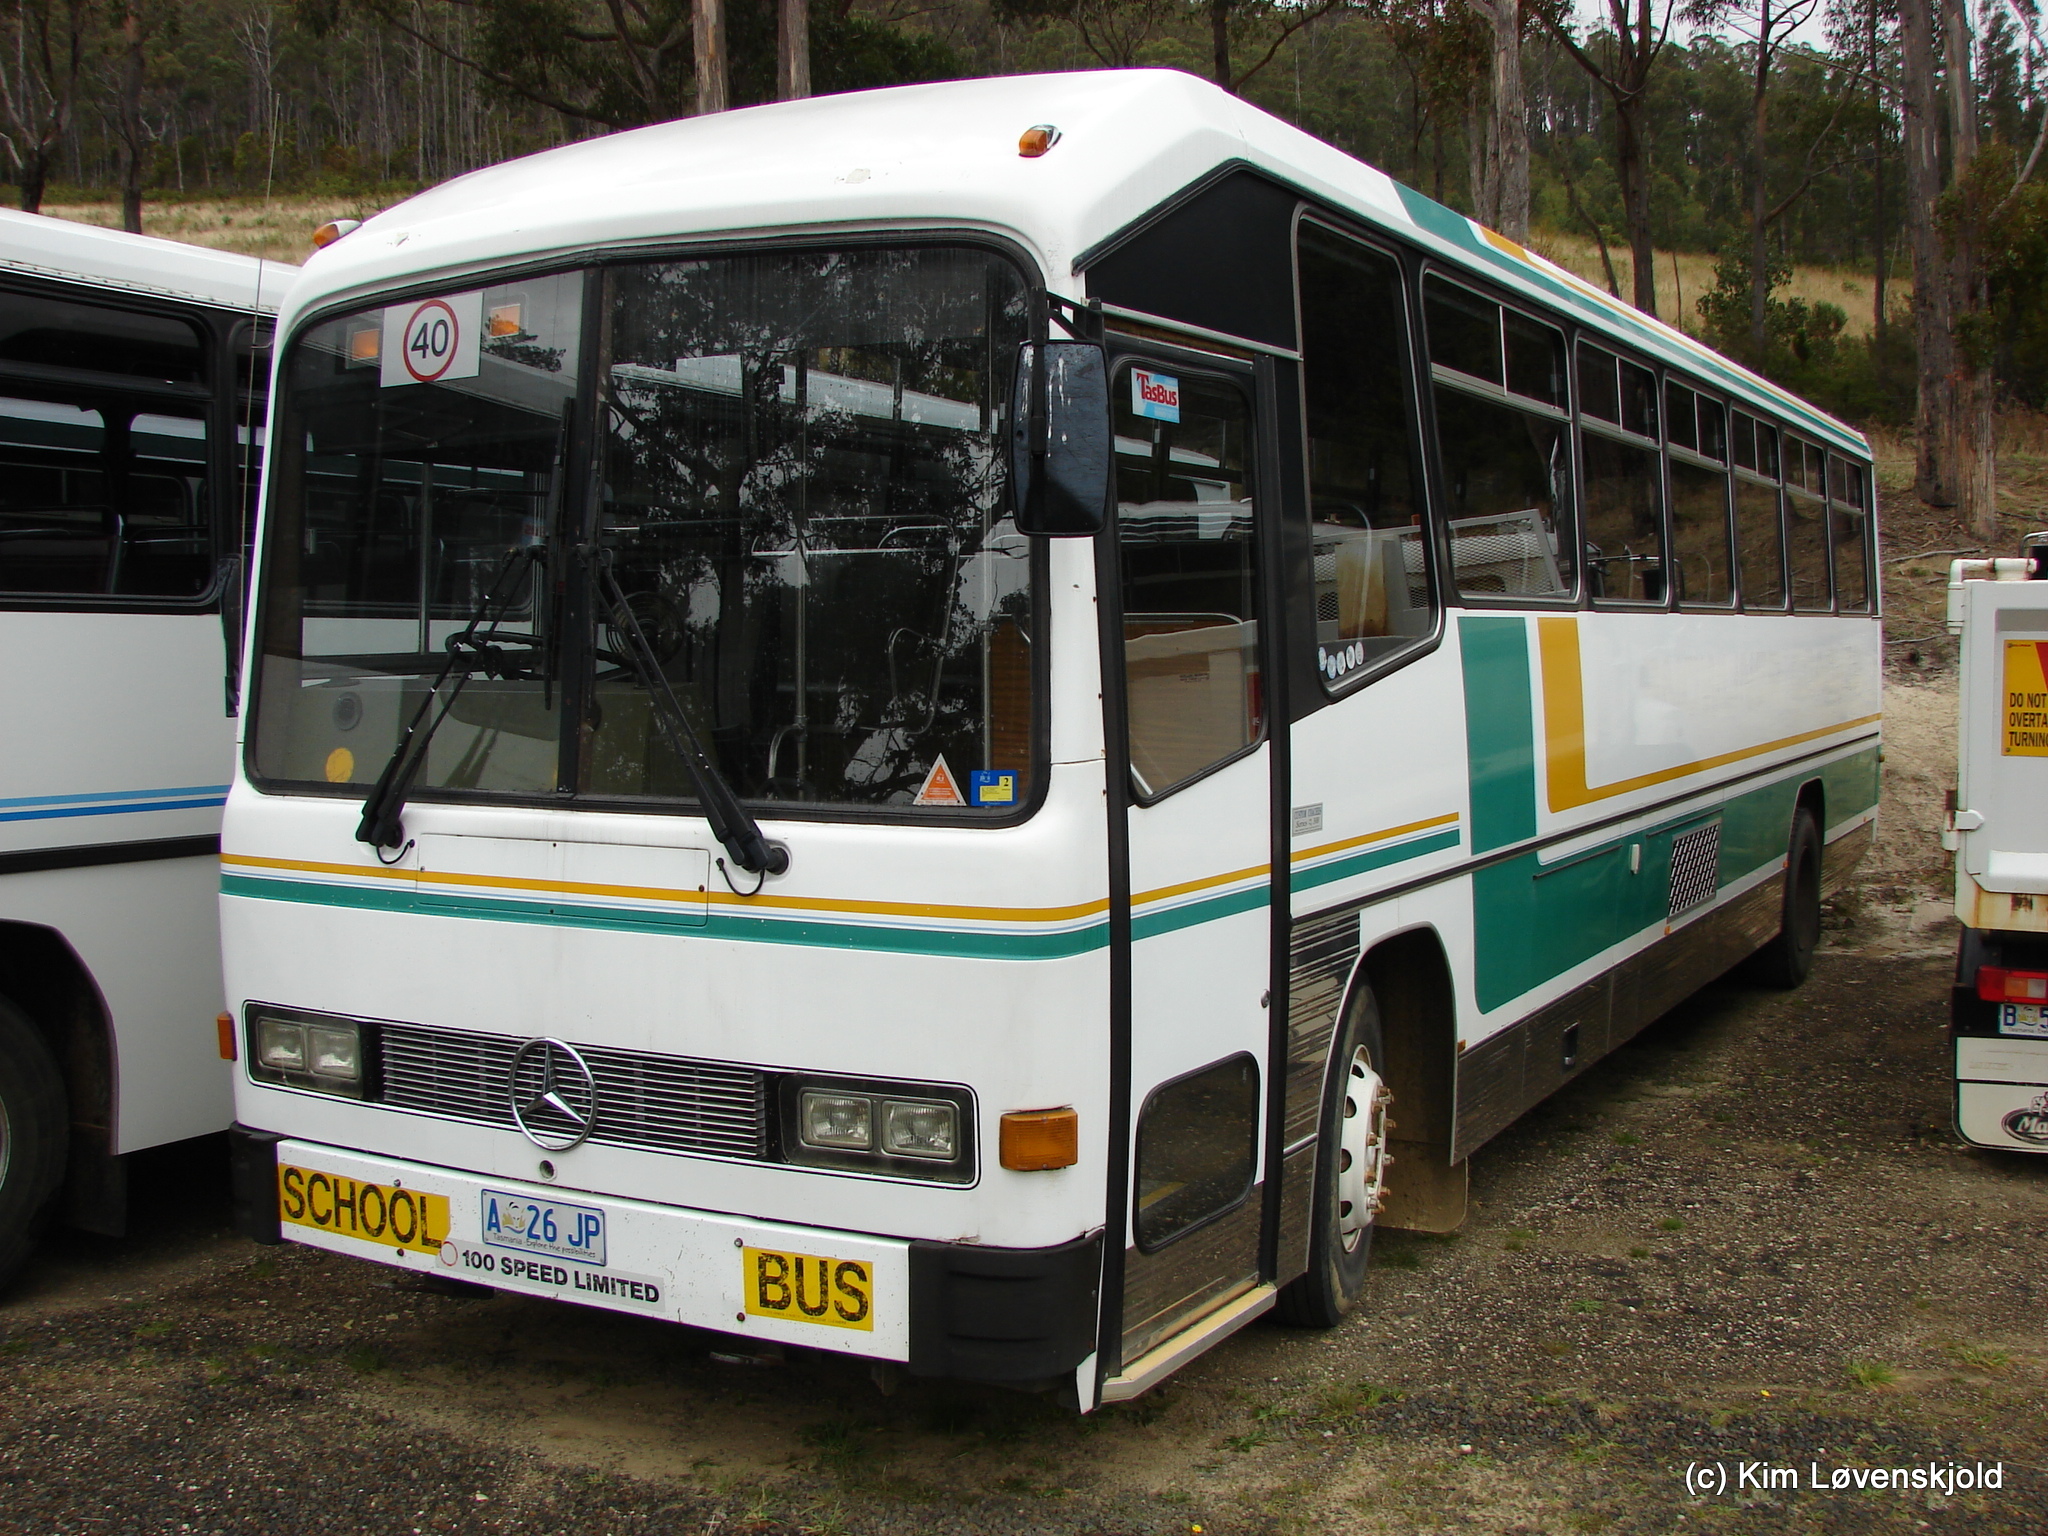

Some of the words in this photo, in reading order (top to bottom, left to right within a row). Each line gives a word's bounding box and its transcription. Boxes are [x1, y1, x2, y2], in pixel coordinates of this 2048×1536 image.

[410, 319, 450, 359] 40
[1136, 372, 1177, 406] TasBus
[2009, 692, 2024, 708] DO
[2026, 692, 2048, 708] NOT
[2008, 711, 2048, 728] OVERTA
[1003, 777, 1009, 786] 2
[2003, 1004, 2016, 1026] B
[283, 1167, 443, 1249] SCHOOL
[487, 1198, 501, 1233] A
[526, 1204, 557, 1242] 26
[567, 1212, 600, 1249] JP
[493, 1232, 522, 1245] Tasmania
[526, 1238, 548, 1250] Explore
[548, 1243, 561, 1252] the
[561, 1246, 596, 1258] possibilities
[462, 1249, 495, 1271] 100
[500, 1256, 568, 1286] SPEED
[574, 1270, 660, 1303] LIMITED
[757, 1252, 869, 1322] BUS
